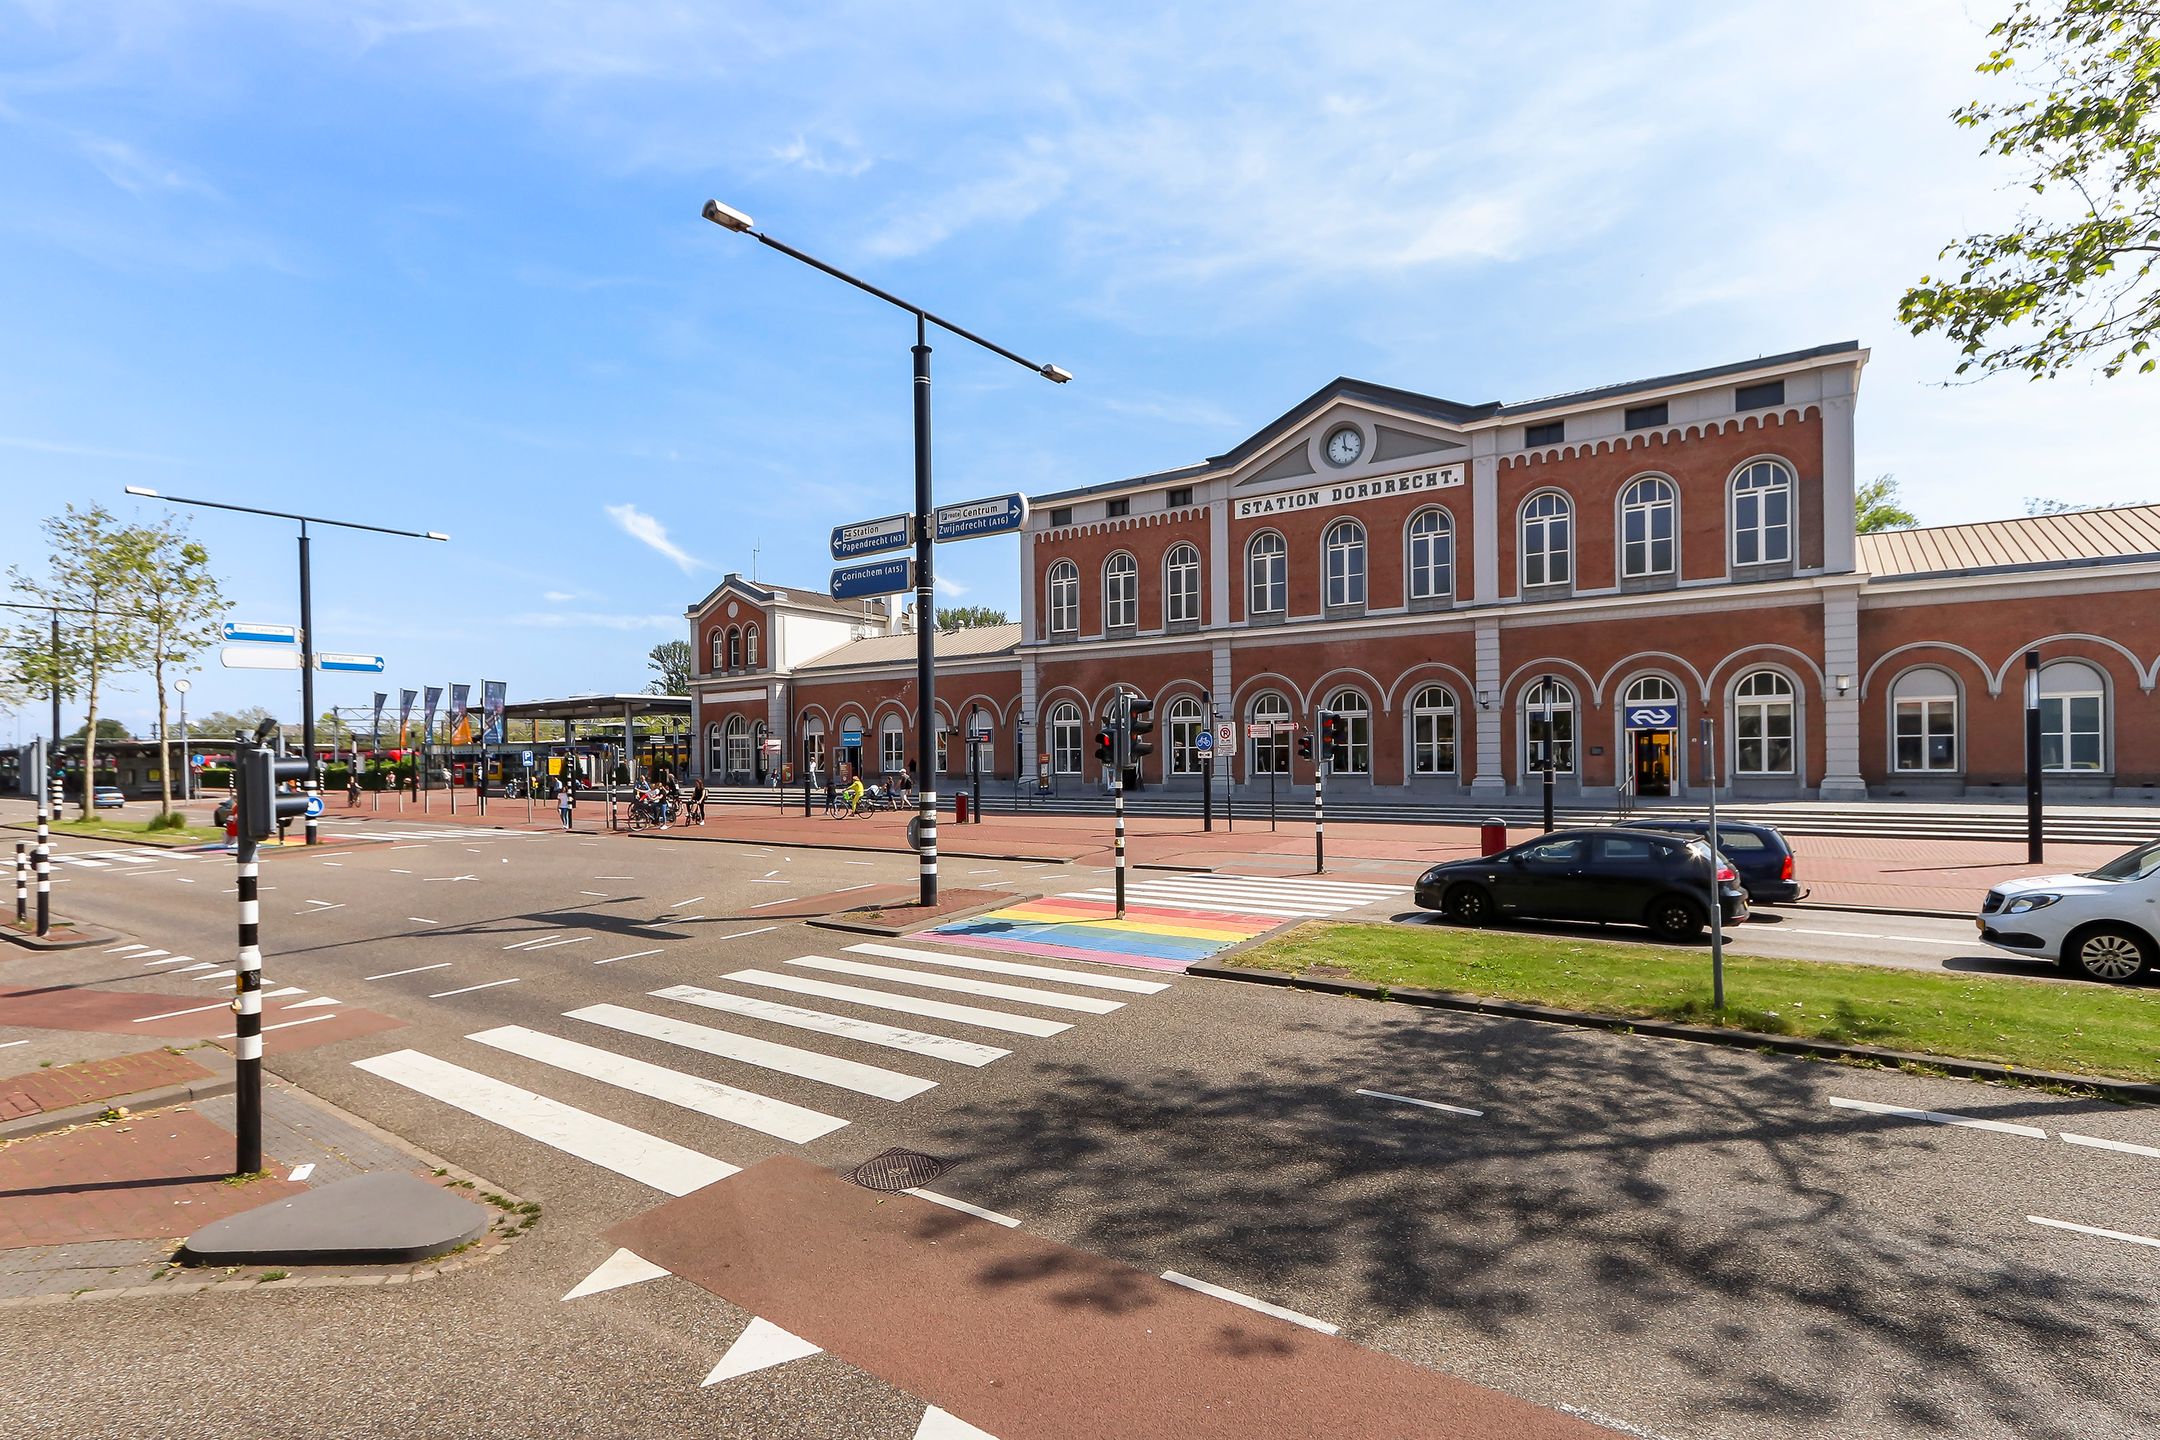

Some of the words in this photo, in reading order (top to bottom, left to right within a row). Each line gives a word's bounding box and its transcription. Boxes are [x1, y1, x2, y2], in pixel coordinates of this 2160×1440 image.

[1241, 491, 1320, 515] STATION
[1332, 470, 1460, 502] DORDRECHT.
[962, 504, 998, 518] Centrum
[853, 526, 879, 537] Station
[938, 520, 987, 535] Zwijndrecht
[989, 515, 1009, 527] (A16)
[842, 536, 888, 552] Papendrecht
[890, 533, 905, 543] (N3)
[841, 568, 883, 581] Gorinchem
[884, 564, 903, 575] (A15)
